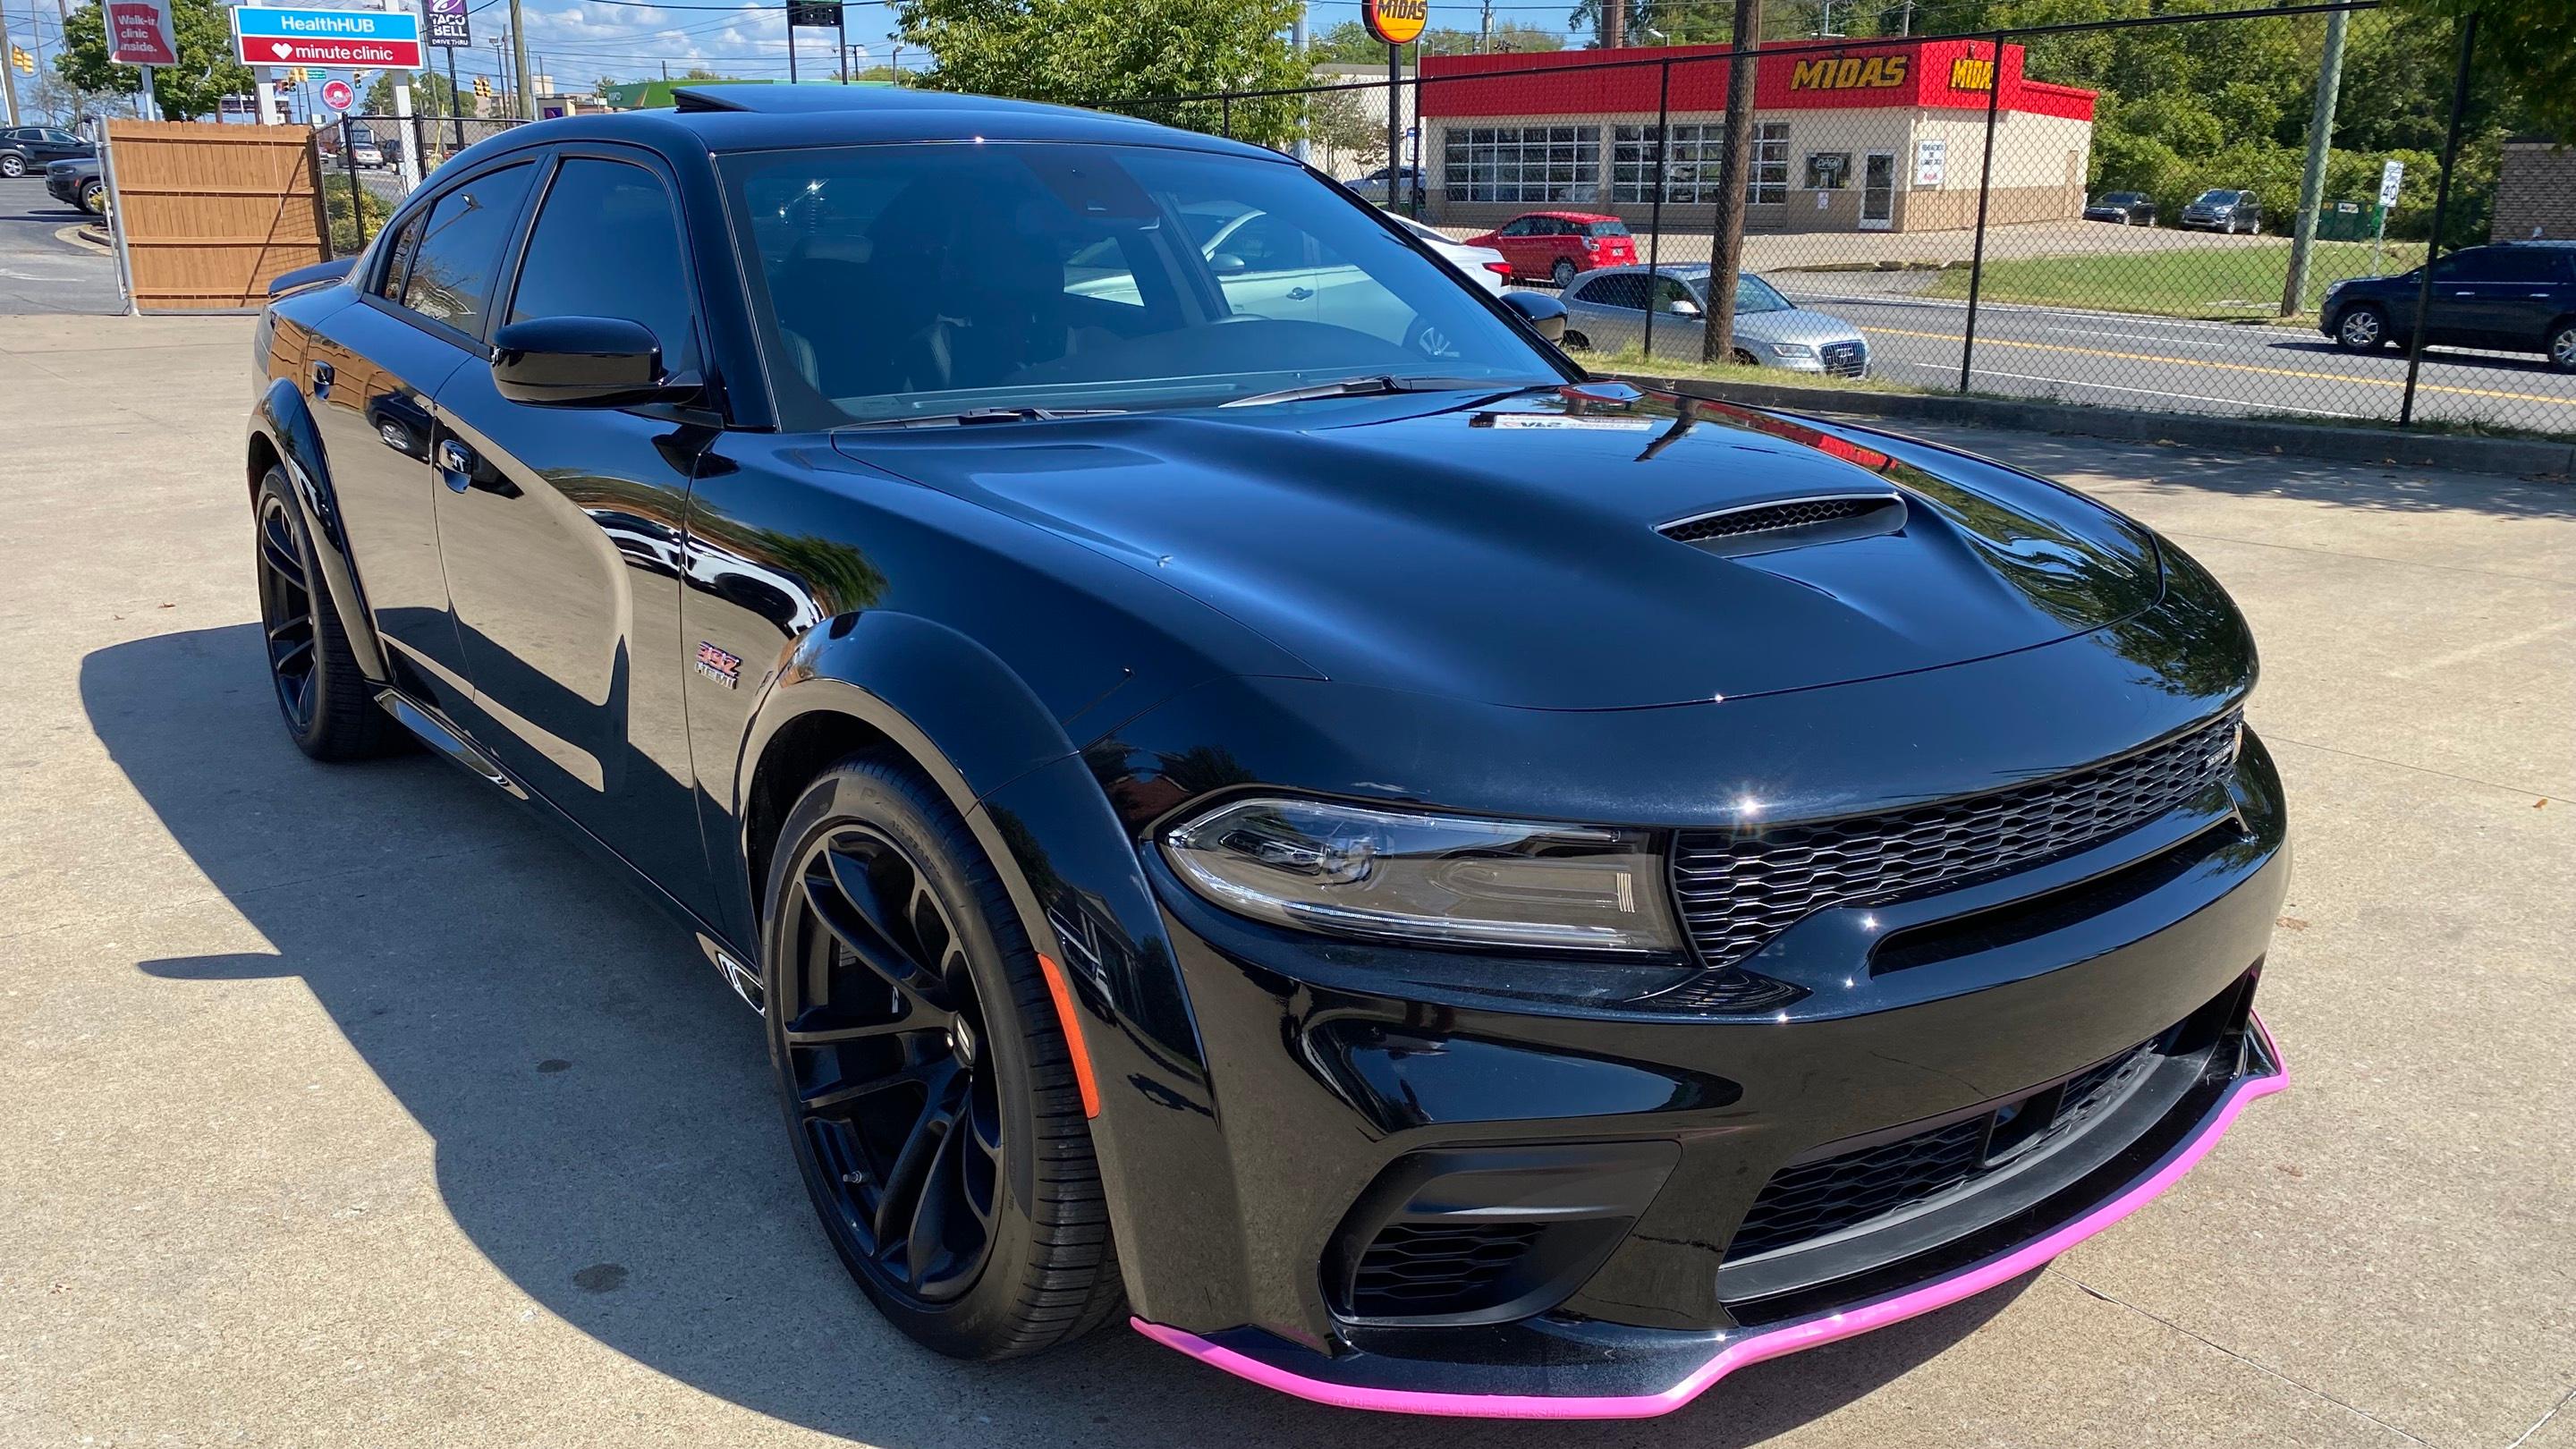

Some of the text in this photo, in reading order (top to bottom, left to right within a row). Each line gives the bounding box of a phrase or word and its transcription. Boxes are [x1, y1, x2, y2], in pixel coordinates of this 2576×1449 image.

[1377, 0, 1426, 20] MIDAS
[281, 15, 376, 33] HealthHUB
[429, 13, 465, 25] TACO
[121, 28, 148, 38] clinic
[433, 24, 467, 37] BELL
[295, 46, 394, 61] minute clinic
[1790, 55, 1909, 90] MIDAS
[2382, 184, 2396, 200] 40
[697, 641, 741, 678] 392
[694, 660, 736, 691] HEMI
